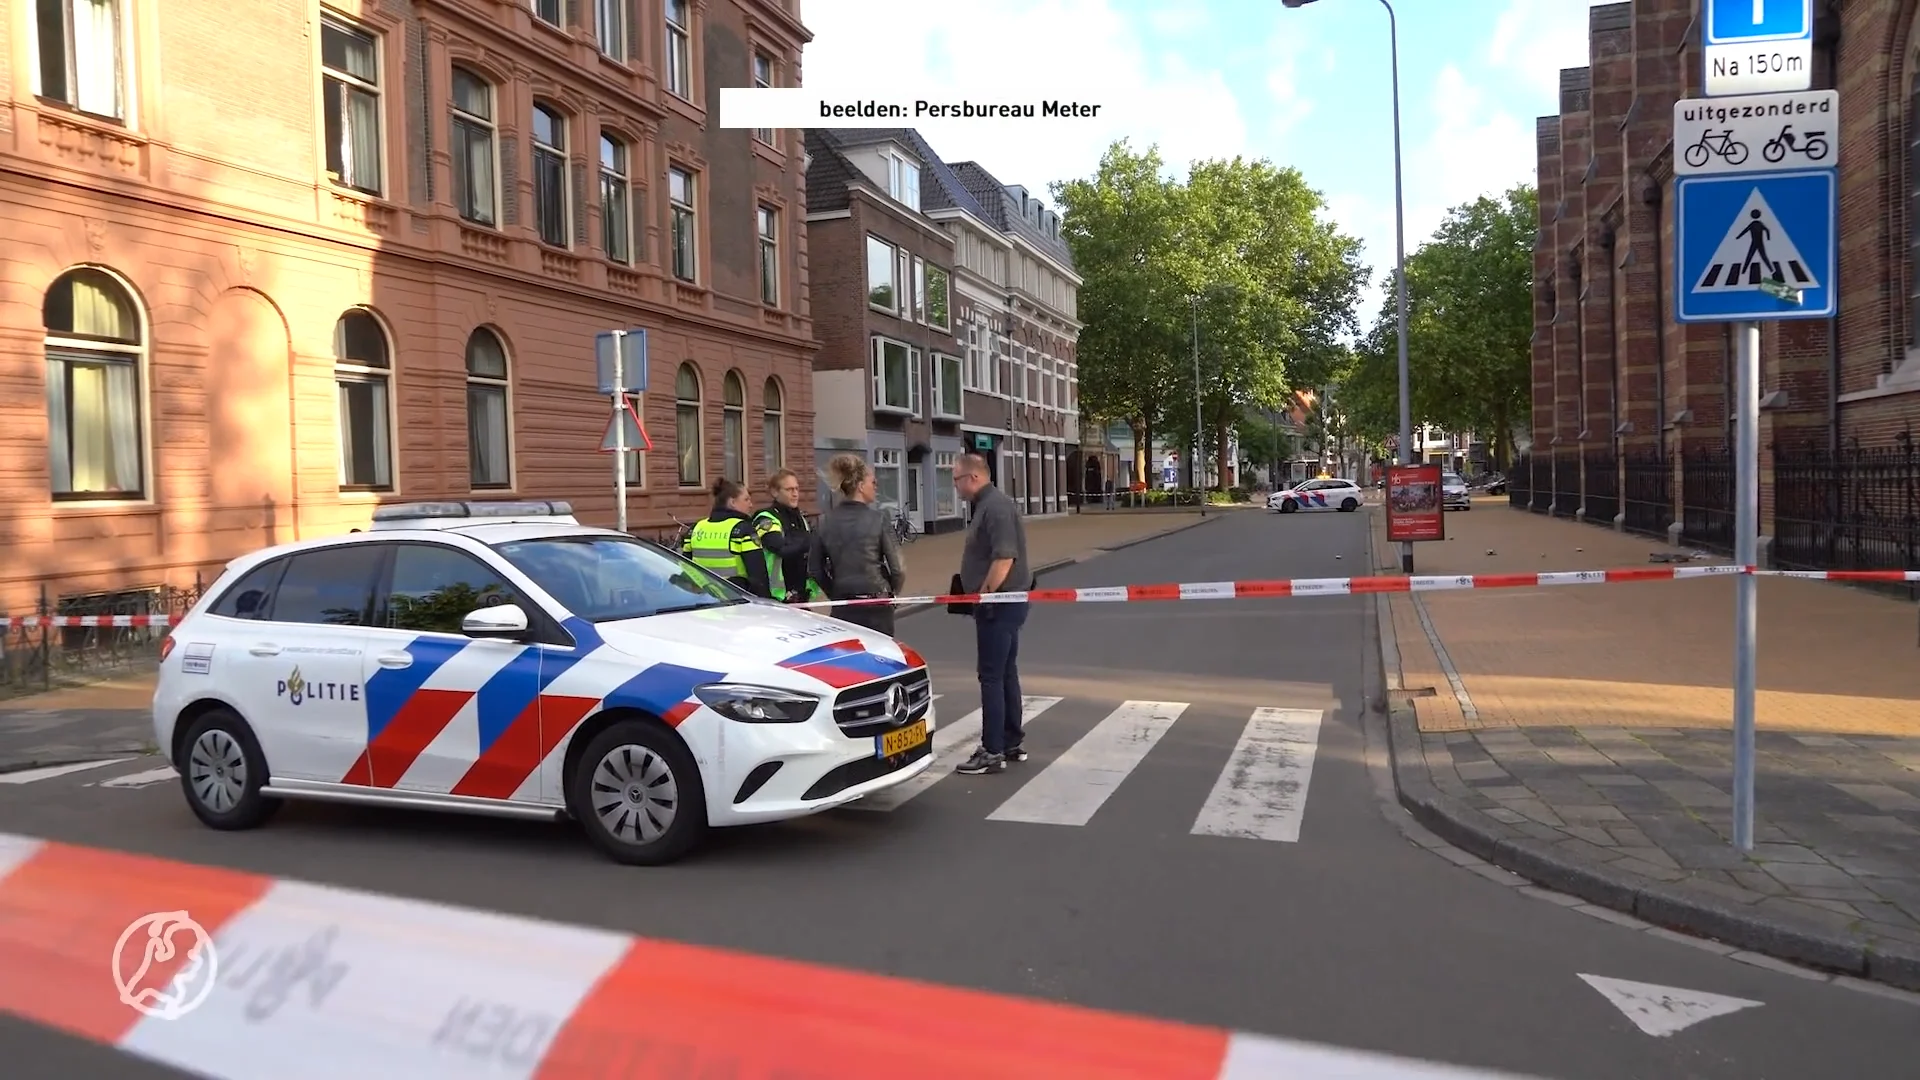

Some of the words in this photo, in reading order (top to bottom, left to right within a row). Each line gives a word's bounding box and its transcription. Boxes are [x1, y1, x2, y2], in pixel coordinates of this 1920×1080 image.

[1713, 57, 1739, 78] Na
[1749, 53, 1803, 75] 150m
[1684, 98, 1830, 123] uitgezonderd
[775, 625, 849, 643] POLITIE
[278, 674, 359, 705] POLITIE
